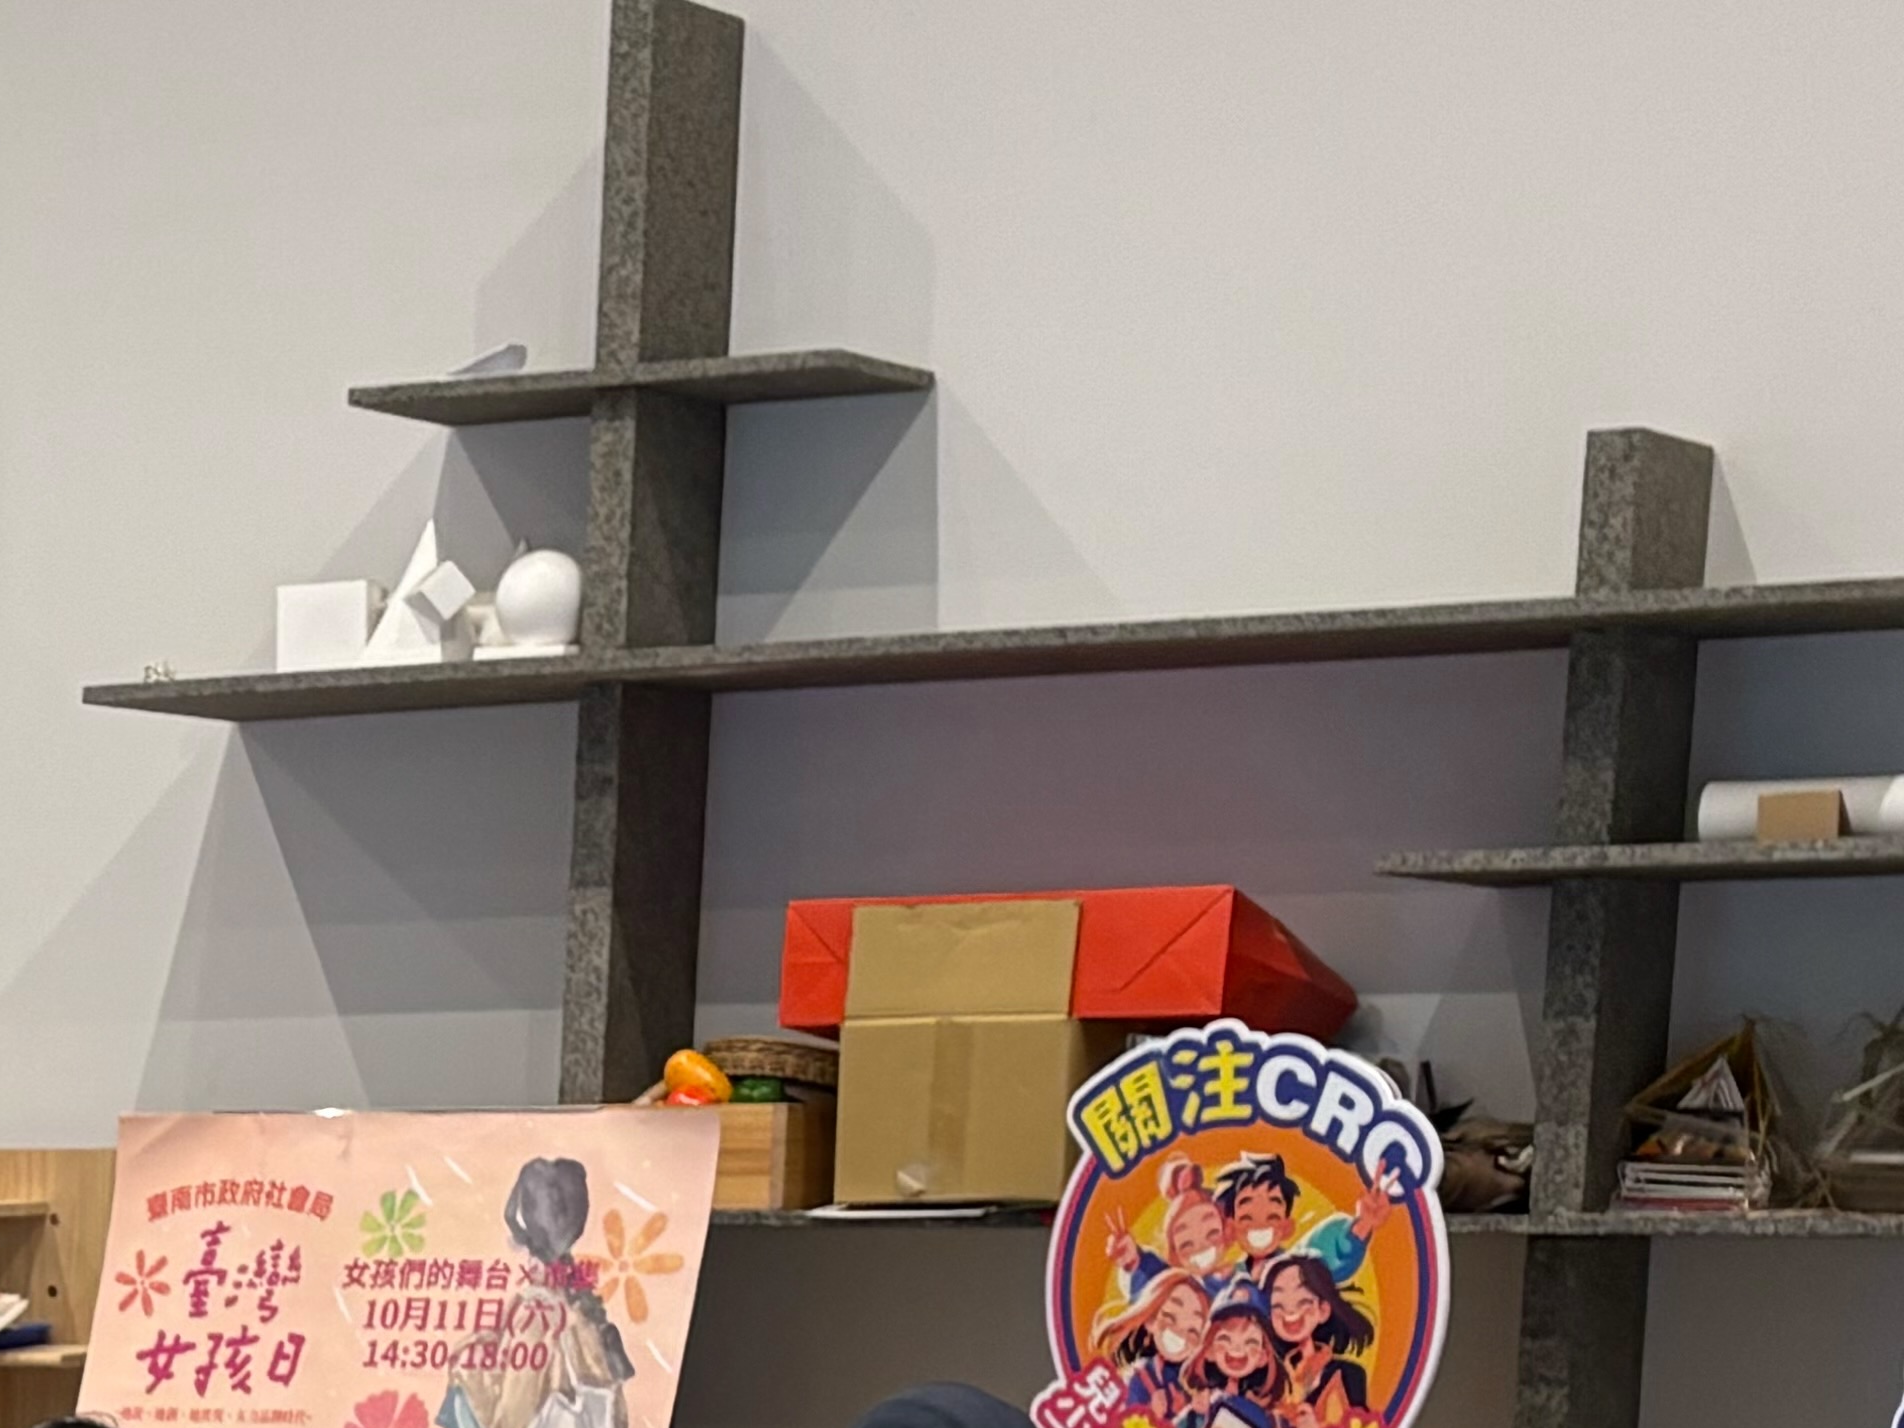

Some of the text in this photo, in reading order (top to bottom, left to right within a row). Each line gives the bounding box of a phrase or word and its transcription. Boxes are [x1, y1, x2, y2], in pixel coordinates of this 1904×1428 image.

[146, 1179, 334, 1222] 臺南市政府社會局
[183, 1220, 302, 1323] 臺灣
[363, 1297, 567, 1339] 10月11日(六)
[136, 1324, 306, 1397] 女孩日
